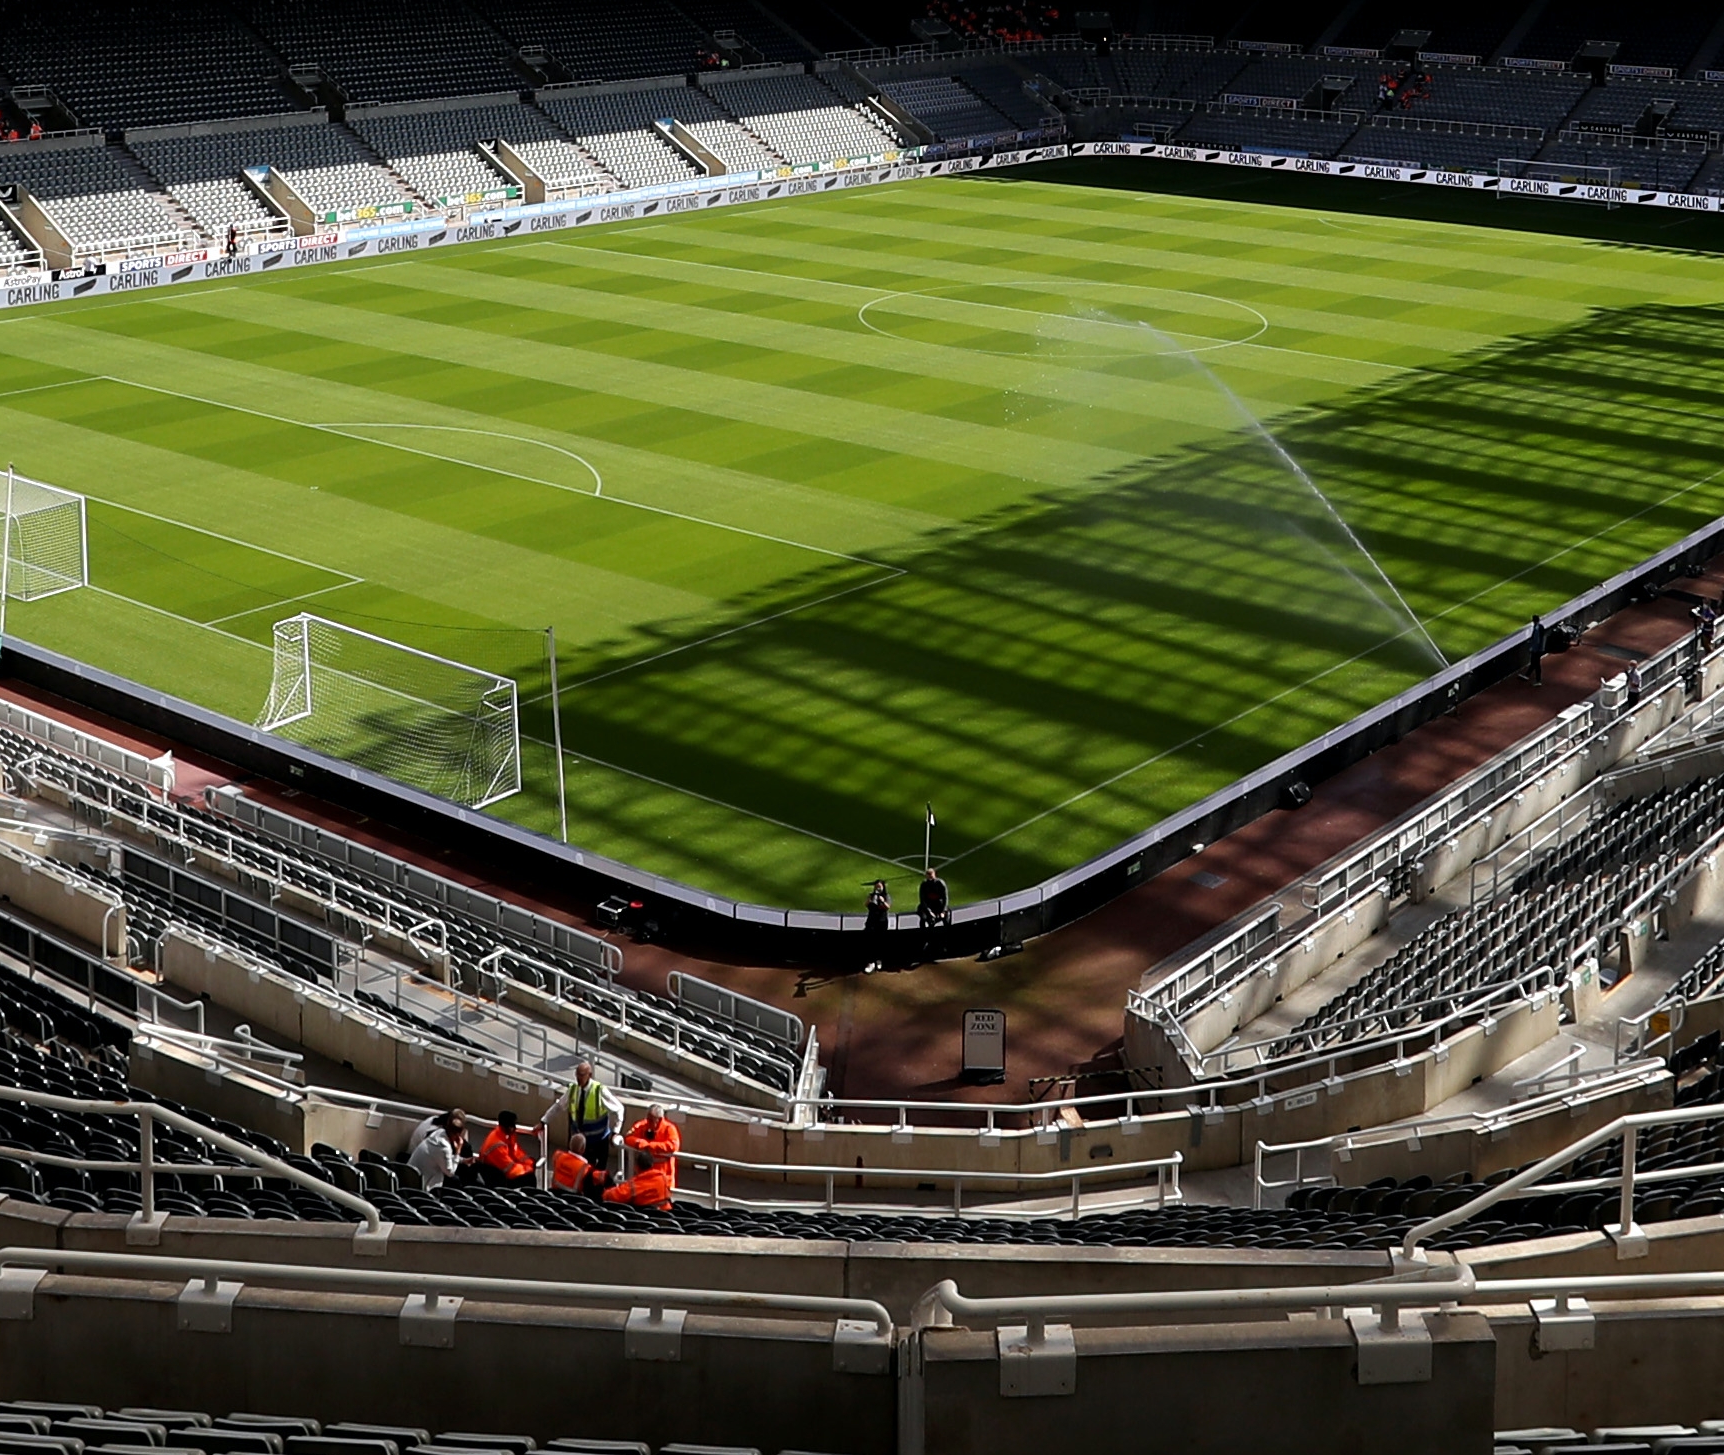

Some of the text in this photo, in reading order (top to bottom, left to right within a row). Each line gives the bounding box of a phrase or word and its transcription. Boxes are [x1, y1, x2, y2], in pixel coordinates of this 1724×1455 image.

[1093, 142, 1130, 154] CARLING
[1164, 146, 1197, 160] CARLING
[818, 157, 869, 171] bet365.com
[948, 158, 973, 172] CARLING
[1229, 151, 1262, 166] CARLING
[1296, 158, 1330, 173] CARLING
[761, 165, 813, 179] bet365.com
[844, 172, 872, 186] CARLING
[1364, 165, 1401, 180] CARLING
[1436, 171, 1473, 187] CARLING
[788, 180, 817, 195] CARLING
[1510, 179, 1549, 194] CARLING
[446, 191, 507, 207] bet365.com
[729, 189, 760, 204] CARLING
[1587, 186, 1628, 203] CARLING
[1667, 194, 1709, 209] CARLING
[666, 196, 699, 212] CARLING
[337, 205, 403, 221] bet365.com
[600, 205, 635, 222] CARLING
[531, 215, 567, 230] CARLING
[456, 225, 495, 242] CARLING
[259, 234, 337, 253] SPORTS DIRECT
[378, 235, 418, 254] CARLING
[120, 252, 206, 272] SPORTS DIRECT
[294, 246, 337, 264] CARLING
[206, 257, 251, 278] CARLING
[4, 274, 42, 288] AstroPay
[110, 270, 158, 291] CARLING
[7, 284, 60, 305] CARLING
